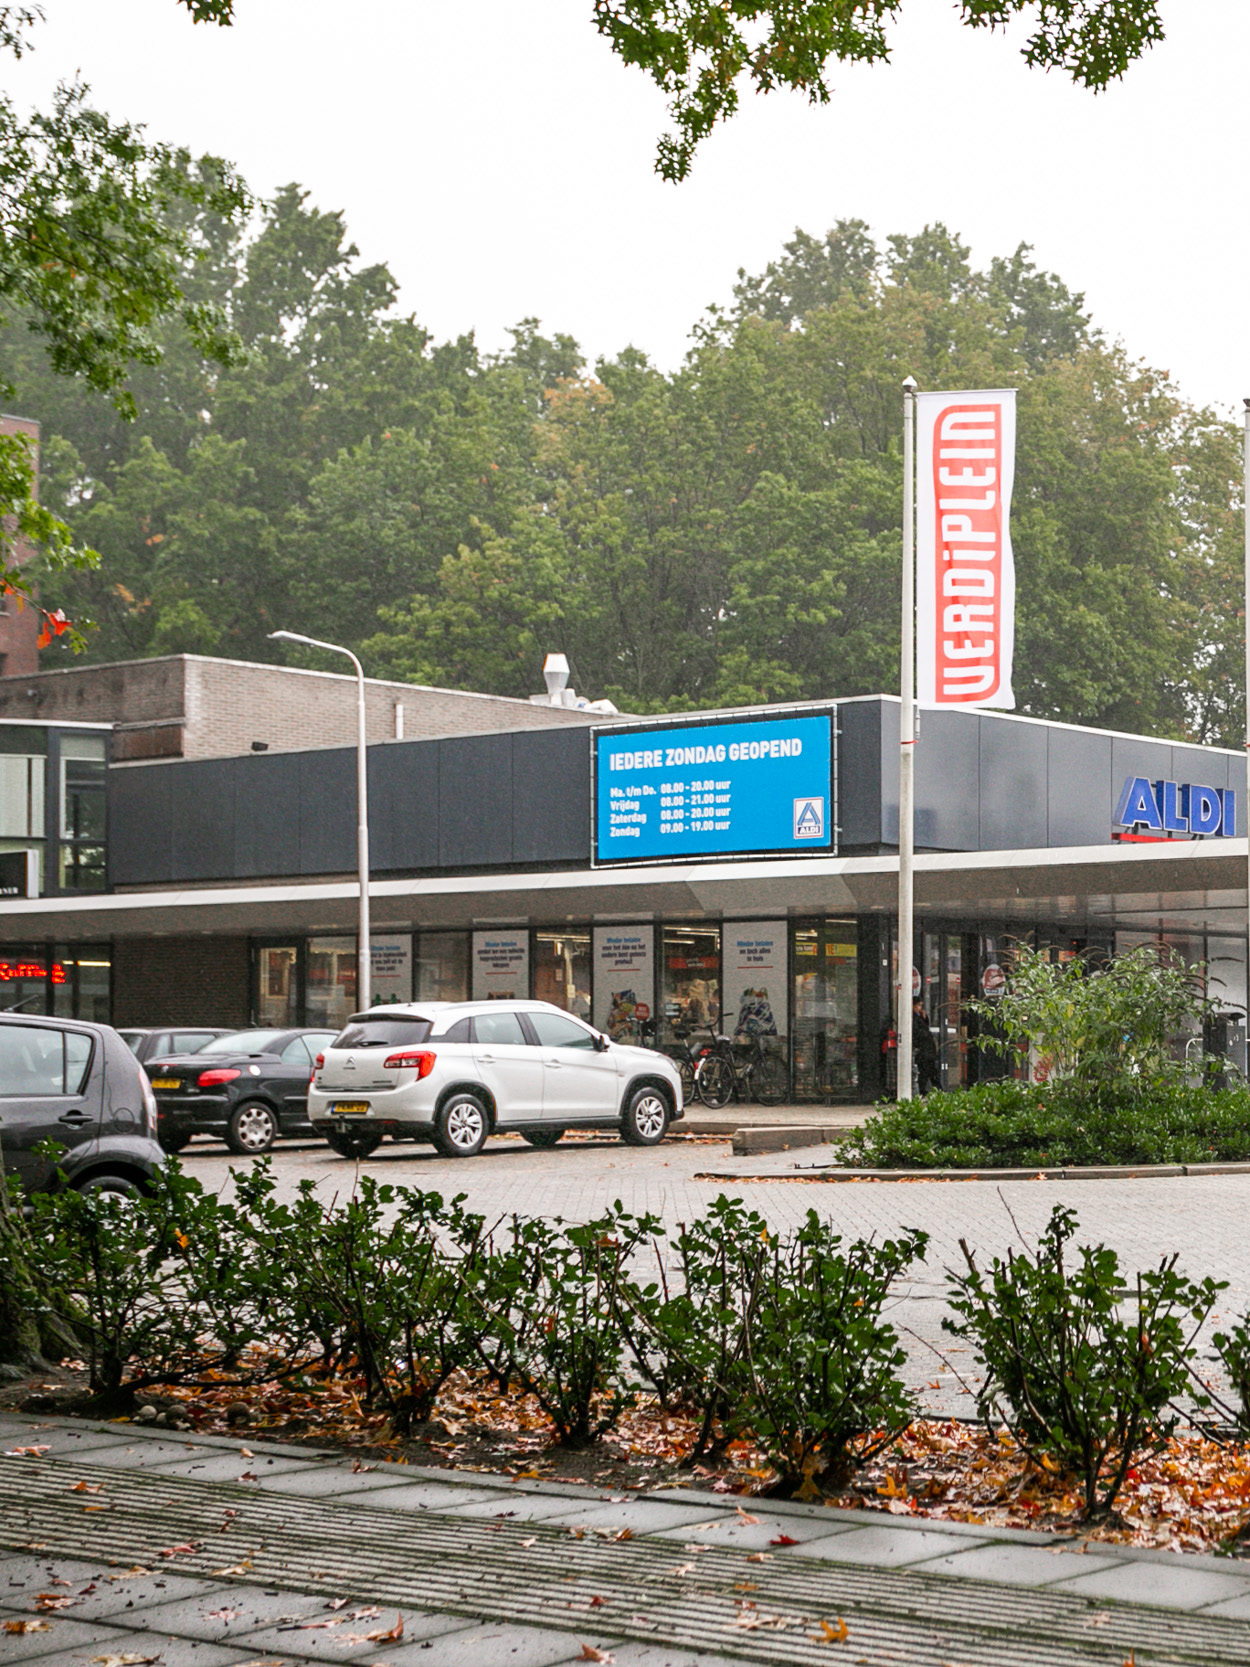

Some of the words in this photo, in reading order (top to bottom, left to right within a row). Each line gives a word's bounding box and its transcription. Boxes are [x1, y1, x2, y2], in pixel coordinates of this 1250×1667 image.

[609, 749, 663, 771] IEDERE
[665, 744, 726, 766] ZONDAG
[728, 738, 802, 761] GEOPEND
[609, 787, 625, 798] Ma.
[626, 785, 641, 797] t/m
[642, 785, 657, 795] Do.
[660, 782, 684, 794] 08.00
[690, 780, 714, 792] 20.00
[715, 780, 731, 790] uur
[609, 800, 640, 812] Vrijdag
[660, 795, 684, 807] 08.00
[690, 793, 714, 805] 21.00
[715, 794, 731, 803] uur
[1114, 776, 1236, 837] ALDI
[609, 812, 647, 824] Zaterdag
[660, 809, 684, 821] 08.00
[690, 807, 714, 818] 20.00
[715, 808, 731, 817] uur
[609, 826, 640, 837] Zondag
[660, 822, 684, 833] 09.00
[690, 820, 714, 832] 19.00
[715, 821, 731, 830] uur
[799, 826, 819, 834] ALDI
